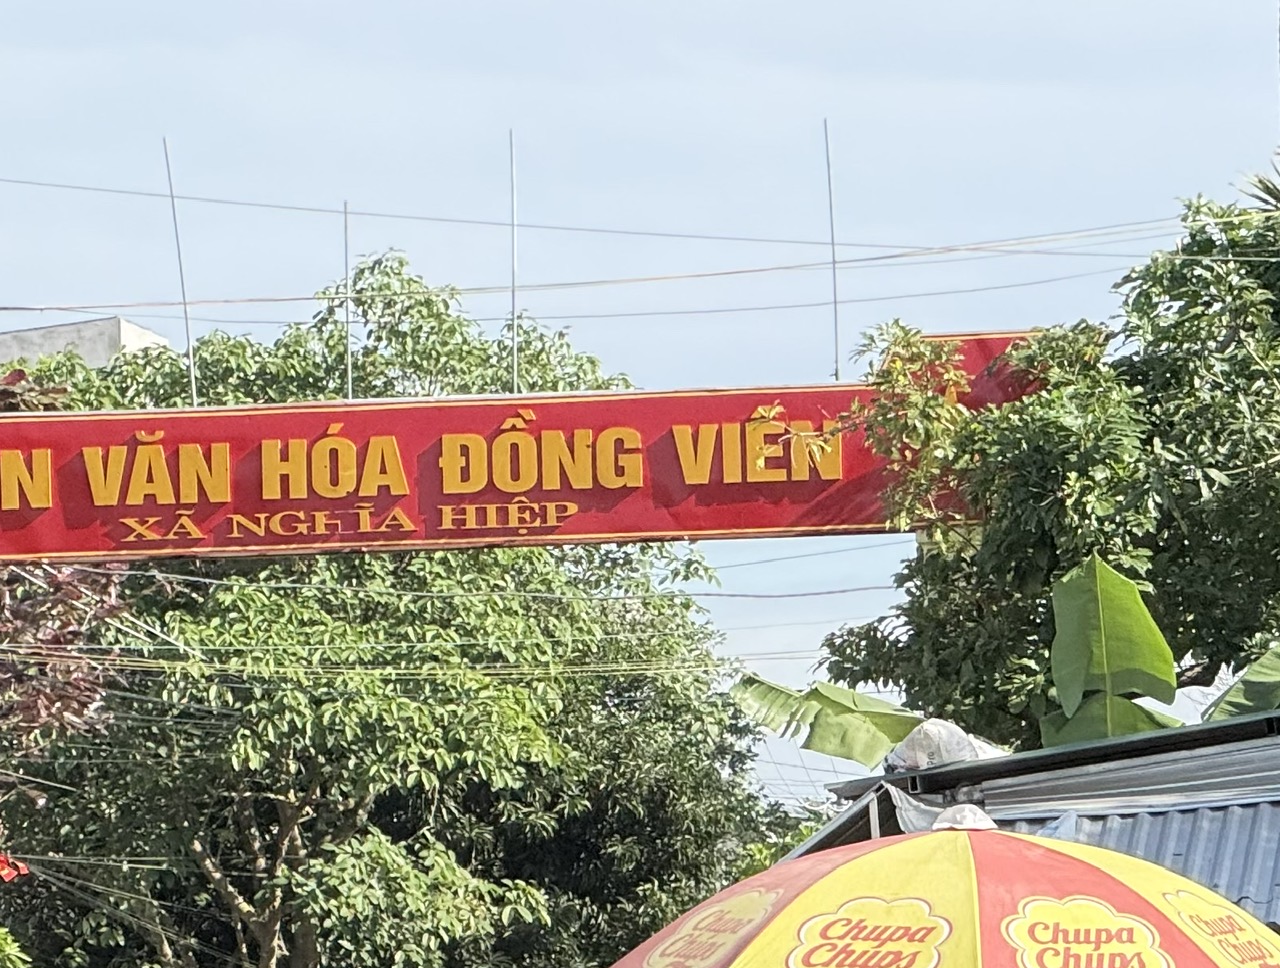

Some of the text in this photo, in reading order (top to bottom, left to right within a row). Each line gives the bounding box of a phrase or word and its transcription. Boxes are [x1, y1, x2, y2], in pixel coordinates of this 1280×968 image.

[81, 430, 233, 506] VĂN
[261, 423, 410, 500] HÓA
[439, 409, 645, 495] ĐỒNG
[120, 496, 578, 542] XÃ NGHĨA HIỆP
[819, 918, 937, 949] Chupa
[1027, 922, 1137, 952] Chupa
